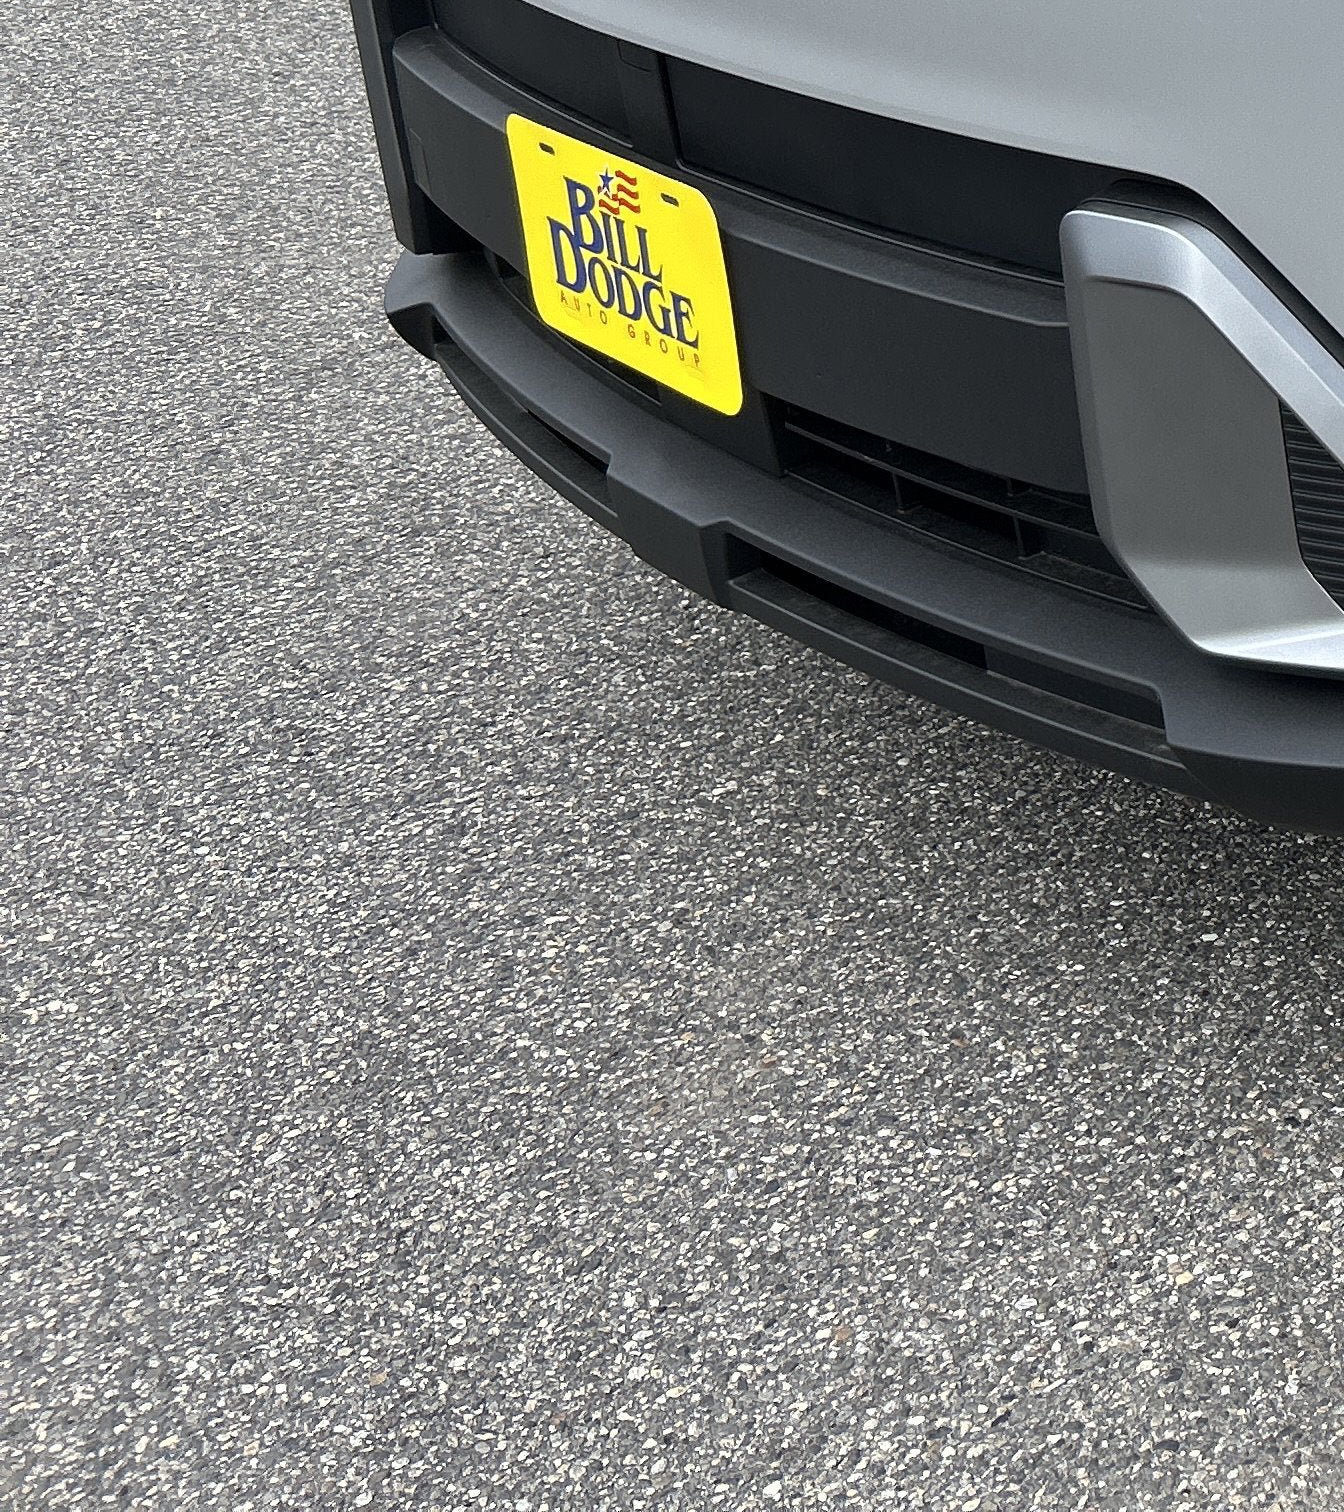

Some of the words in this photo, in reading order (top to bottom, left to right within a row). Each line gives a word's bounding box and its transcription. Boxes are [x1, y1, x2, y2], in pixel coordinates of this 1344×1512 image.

[547, 216, 700, 350] DODGE
[563, 175, 663, 284] BILL
[560, 290, 608, 325] AUTO
[627, 324, 701, 368] GROUP
